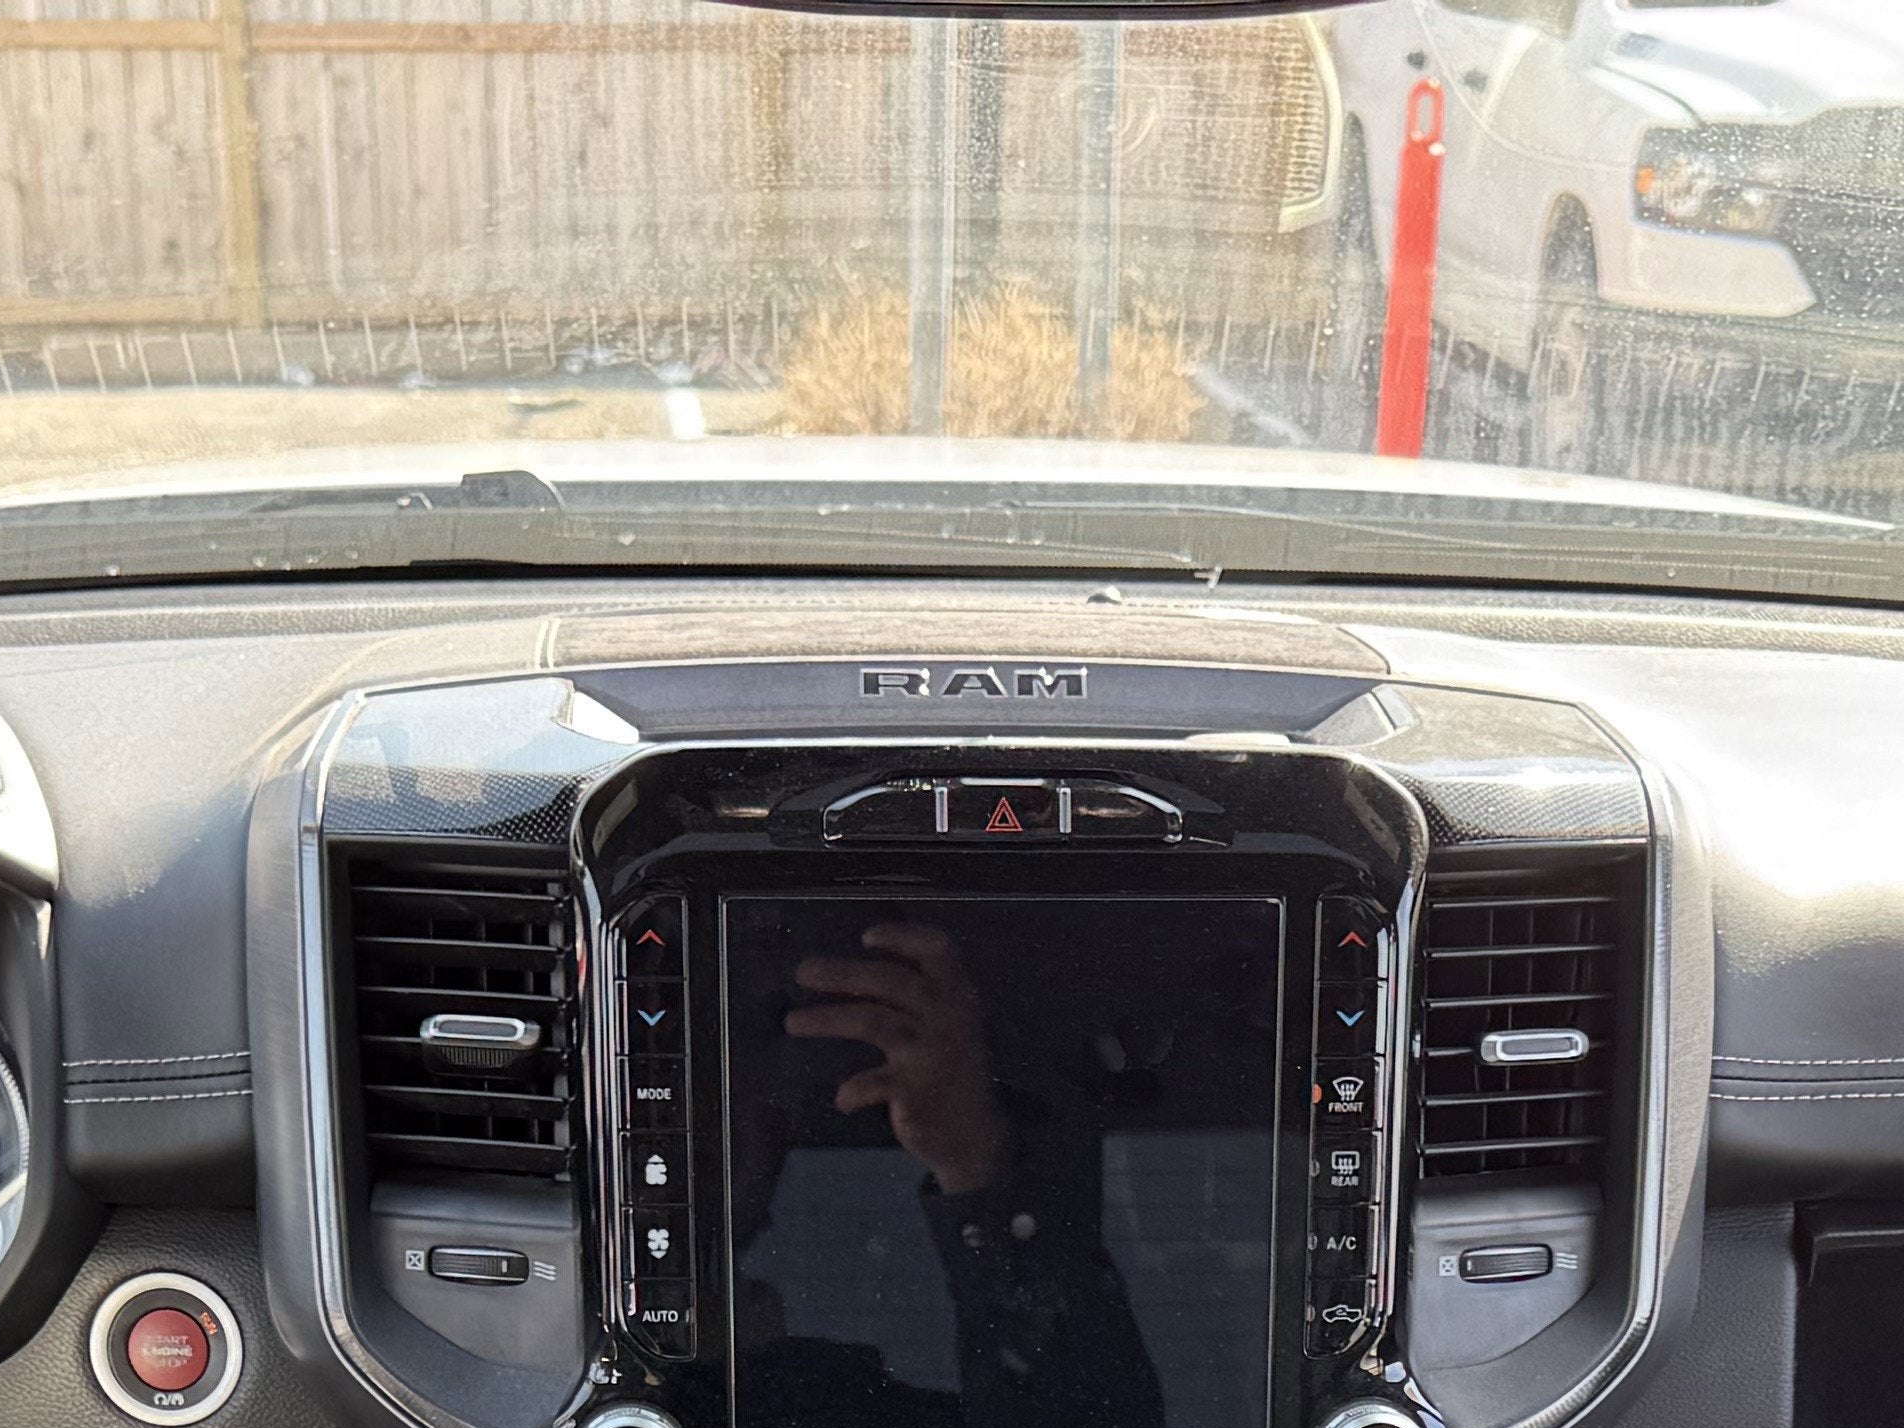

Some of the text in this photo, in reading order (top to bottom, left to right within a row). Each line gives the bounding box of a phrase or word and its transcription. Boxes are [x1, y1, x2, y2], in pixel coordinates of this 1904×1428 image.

[860, 667, 1087, 698] RAM
[637, 1088, 672, 1100] MODE
[1328, 1102, 1364, 1113] FRONT
[1331, 1176, 1359, 1186] REAR
[1327, 1236, 1357, 1250] A/C
[642, 1310, 679, 1323] AUTO
